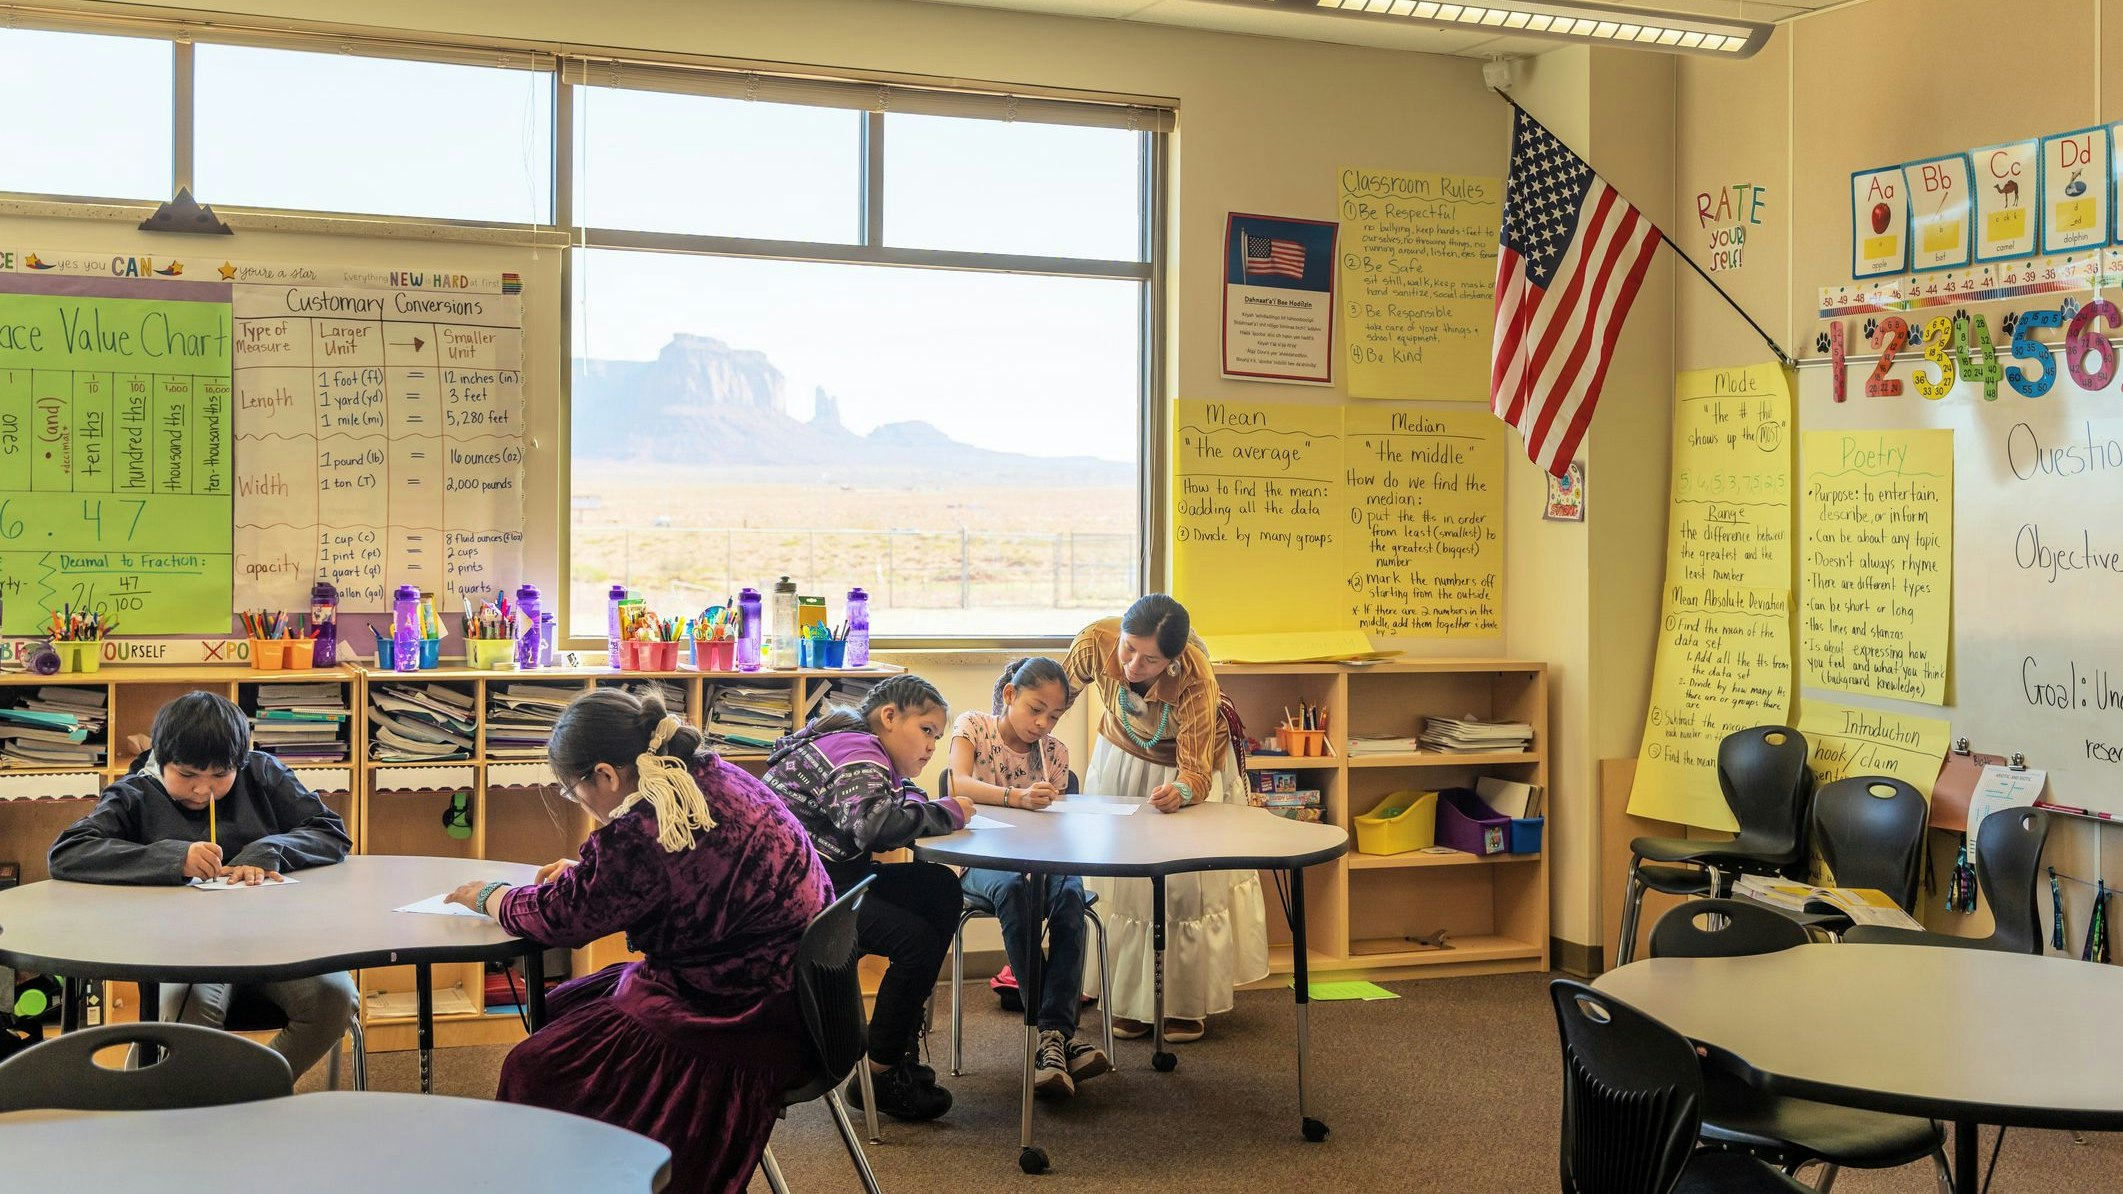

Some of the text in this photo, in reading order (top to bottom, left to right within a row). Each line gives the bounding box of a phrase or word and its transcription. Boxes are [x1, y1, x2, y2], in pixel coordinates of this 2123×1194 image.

[2061, 135, 2090, 168] Dd
[1990, 152, 2021, 178] Cc
[1343, 170, 1483, 198] Classroom Rules
[1868, 176, 1894, 201] Aa
[1922, 165, 1951, 193] Bb
[1359, 204, 1456, 222] Be Respectful
[1697, 183, 1765, 229] RATE
[1416, 224, 1434, 236] keep
[2063, 232, 2089, 246] dolphin
[1996, 241, 2015, 252] camel
[112, 257, 152, 277] CAN
[1364, 257, 1423, 273] Be Safe
[390, 272, 424, 286] NEW
[434, 274, 469, 288] HARD
[1908, 274, 2017, 297] -45 -44 -43 -42 -41 -40
[286, 289, 483, 319] Customary Conversions
[1366, 304, 1453, 321] Be Responsible
[60, 308, 133, 355] Value
[141, 311, 228, 357] Chart
[242, 321, 288, 341] Type of
[320, 322, 372, 340] Larger
[443, 329, 496, 345] Smaller
[236, 341, 290, 353] Measure
[325, 340, 358, 355] Unit
[449, 347, 476, 359] Unit
[1367, 347, 1422, 363] Be Kind
[2005, 310, 2063, 398] 5
[2065, 300, 2122, 391] 6
[1830, 321, 1847, 403] 1
[1865, 316, 1909, 398] 2
[1912, 315, 1955, 401] 3
[1954, 313, 2003, 402] 4
[334, 371, 358, 387] foot
[460, 373, 494, 384] inches
[1714, 370, 1758, 394] Mode
[241, 388, 293, 418] Length
[464, 388, 487, 401] feet
[337, 414, 359, 426] mile
[446, 412, 509, 427] 5,280 feet
[1206, 403, 1267, 426] Mean
[1392, 412, 1446, 433] Median
[2, 414, 19, 455] ones
[1688, 427, 1737, 450] shows up
[334, 452, 364, 469] pound
[464, 452, 500, 465] ounces
[1842, 436, 1908, 478] Poetry
[238, 472, 289, 498] Width
[335, 476, 352, 488] ton
[446, 476, 512, 491] 2,000 pounds
[1184, 478, 1328, 497] How find the mean:
[1346, 468, 1487, 491] How do we find the
[1366, 491, 1422, 506] median:
[1814, 482, 1860, 506] Purpose:
[84, 499, 146, 542] 4 7
[1188, 497, 1320, 525] adding all the data
[1367, 508, 1487, 529] put the order
[1708, 504, 1745, 525] Range
[1890, 505, 1929, 524] inform
[455, 533, 475, 544] fluid
[1236, 527, 1333, 551] by many groups
[1371, 525, 1431, 538] from least
[1680, 519, 1750, 543] the difference
[1816, 528, 1941, 551] Can about any topic
[335, 534, 354, 548] cup
[1391, 541, 1433, 556] greatest
[61, 554, 109, 570] Decimal
[121, 556, 134, 568] to
[333, 548, 356, 565] pint
[457, 548, 479, 558] cups
[1376, 556, 1413, 568] number
[1699, 549, 1737, 567] greatest
[235, 553, 301, 580] Capacity
[457, 562, 484, 573] pints
[1685, 565, 1745, 582] least number
[1859, 552, 1938, 576] always rhyme
[120, 576, 139, 590] 47
[332, 567, 360, 584] quart
[1434, 573, 1477, 587] numbers
[458, 582, 492, 598] quarts
[1368, 586, 1408, 605] starting
[1857, 576, 1932, 598] different types
[115, 597, 144, 612] 100
[1671, 585, 1785, 612] Mean Absolute Deviation
[1677, 618, 1699, 633] Find
[1870, 623, 1905, 640] stanzas
[1674, 634, 1699, 648] data
[101, 641, 166, 661] OURSELF
[1839, 710, 1921, 748] Introduction
